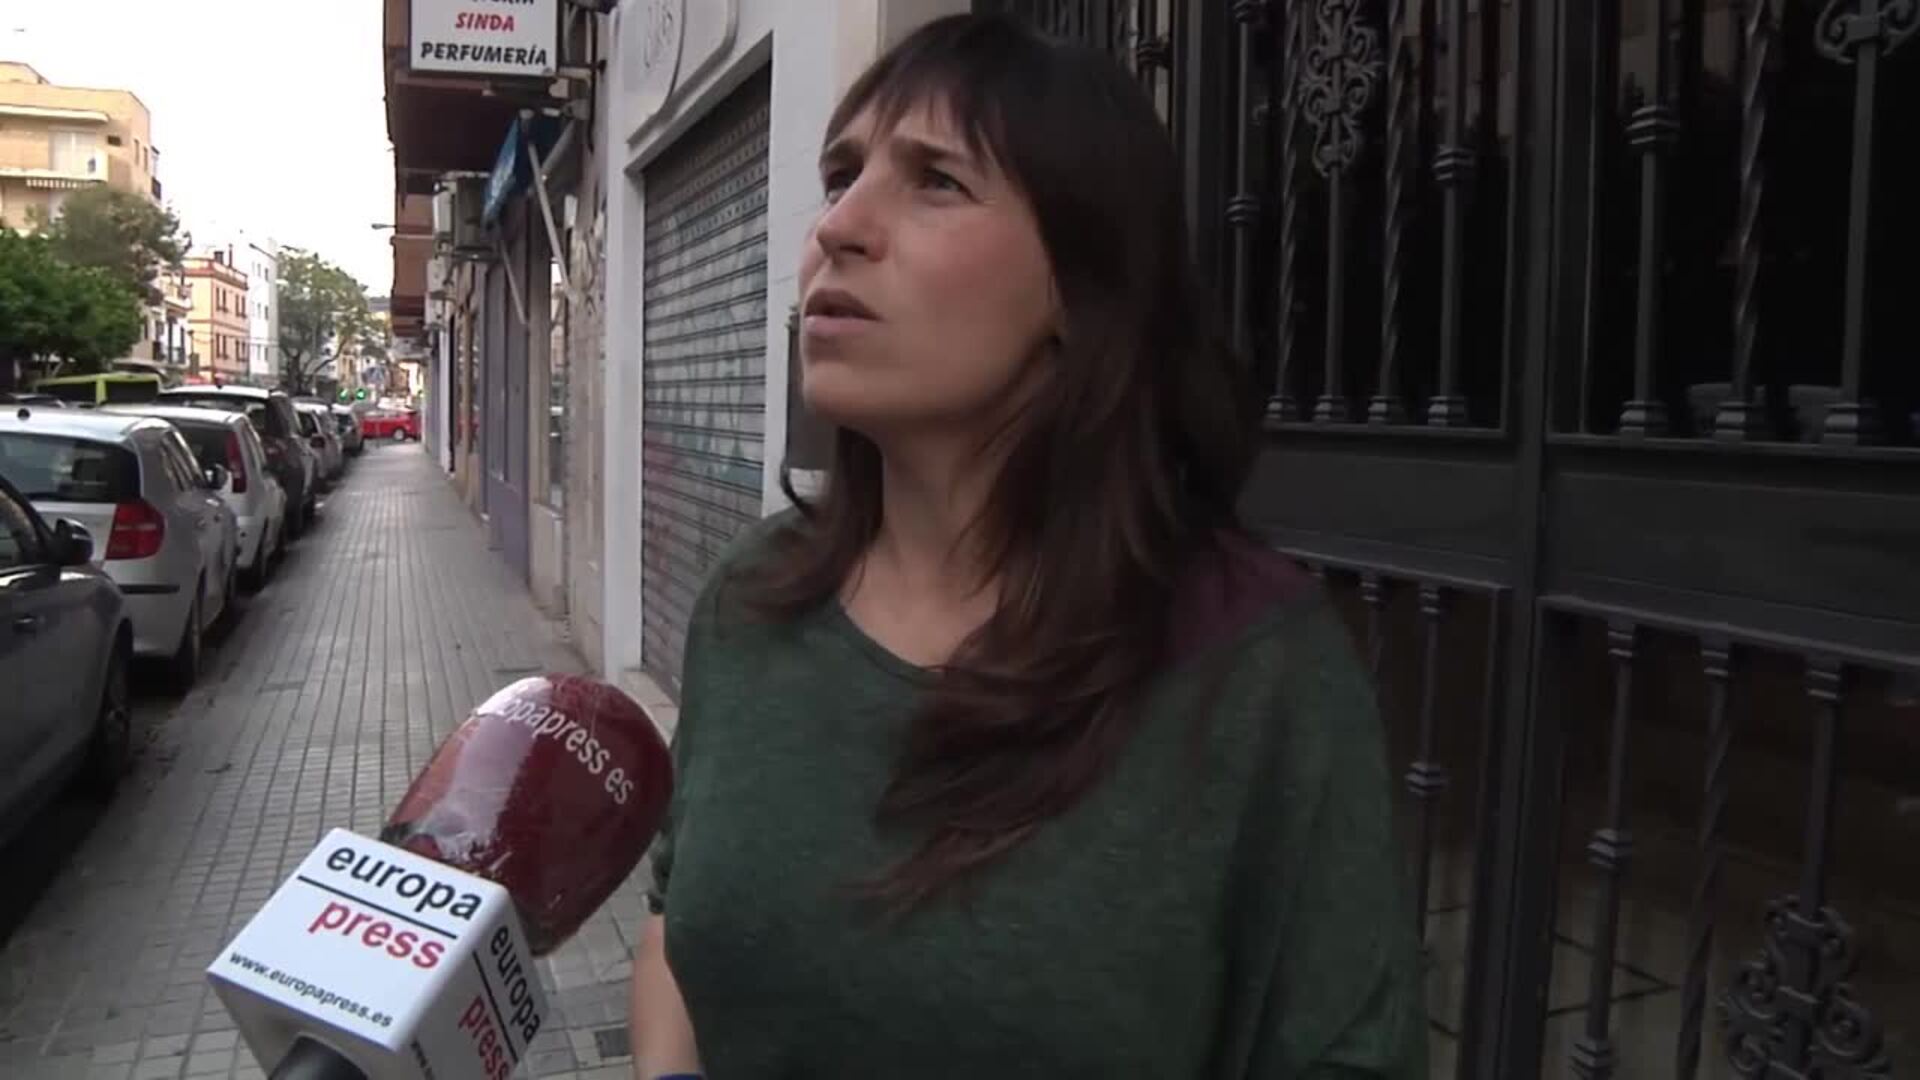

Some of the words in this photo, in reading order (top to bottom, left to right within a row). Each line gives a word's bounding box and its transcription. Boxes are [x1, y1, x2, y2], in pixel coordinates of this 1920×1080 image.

[420, 41, 548, 66] PERFUMERÍA
[455, 12, 515, 32] SINDA
[326, 846, 483, 921] europa
[308, 901, 446, 970] press
[229, 951, 393, 1028] www.europapress.es
[490, 925, 541, 1045] europa
